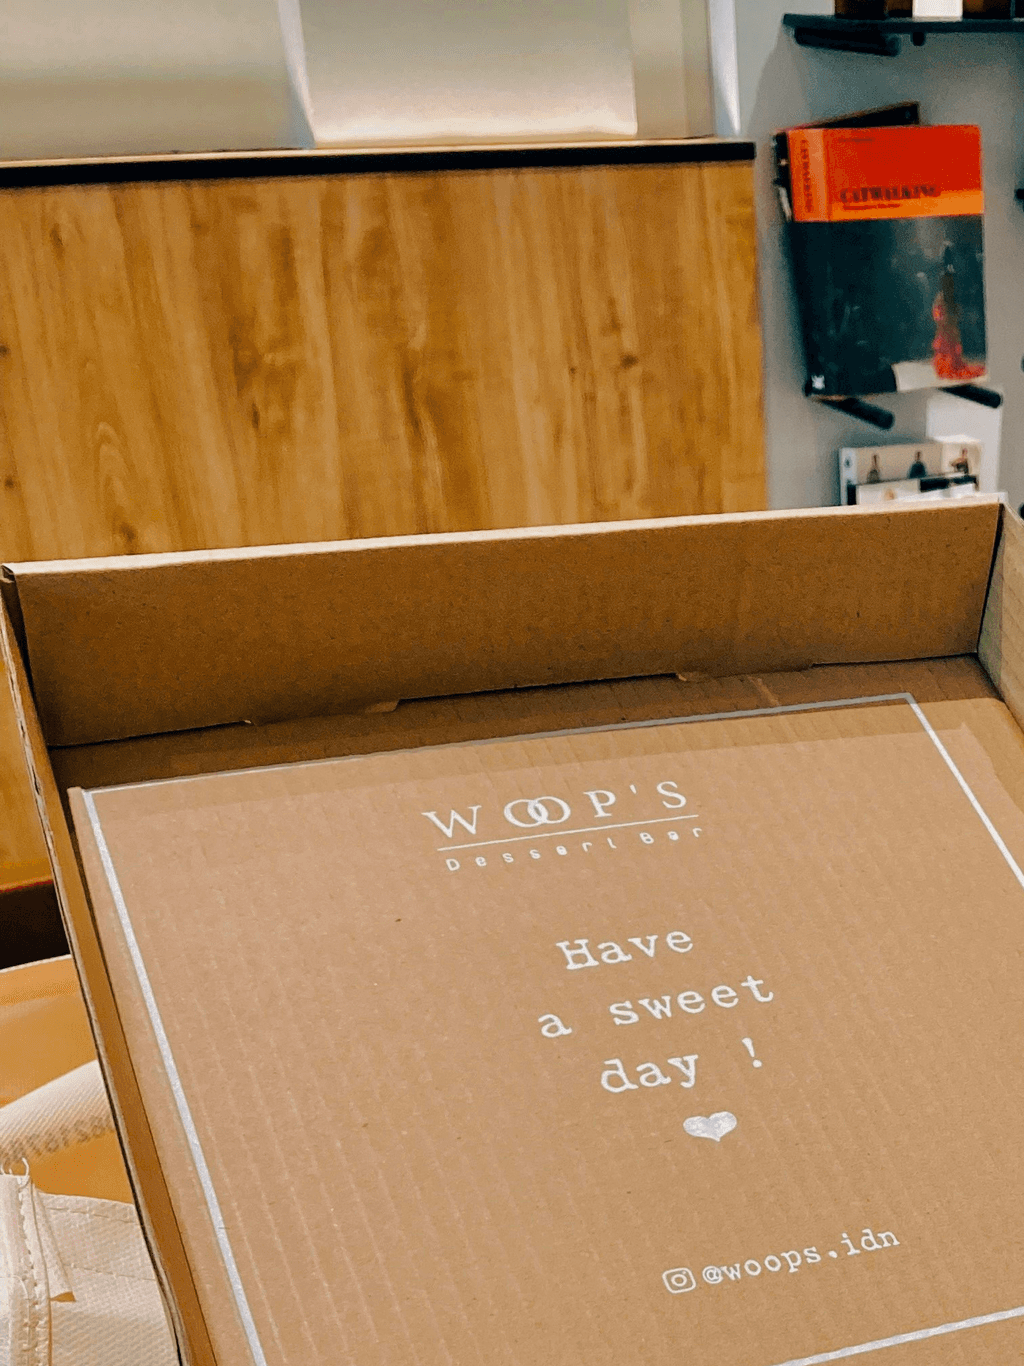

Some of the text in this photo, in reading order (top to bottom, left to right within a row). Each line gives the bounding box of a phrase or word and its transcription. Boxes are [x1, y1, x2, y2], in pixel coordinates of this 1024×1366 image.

[421, 781, 687, 839] WOOP'S
[446, 827, 703, 871] Dessert Bar
[556, 931, 693, 970] Have
[538, 975, 773, 1038] a sweet
[600, 1037, 763, 1093] day !
[702, 1228, 900, 1285] @woops.idn
